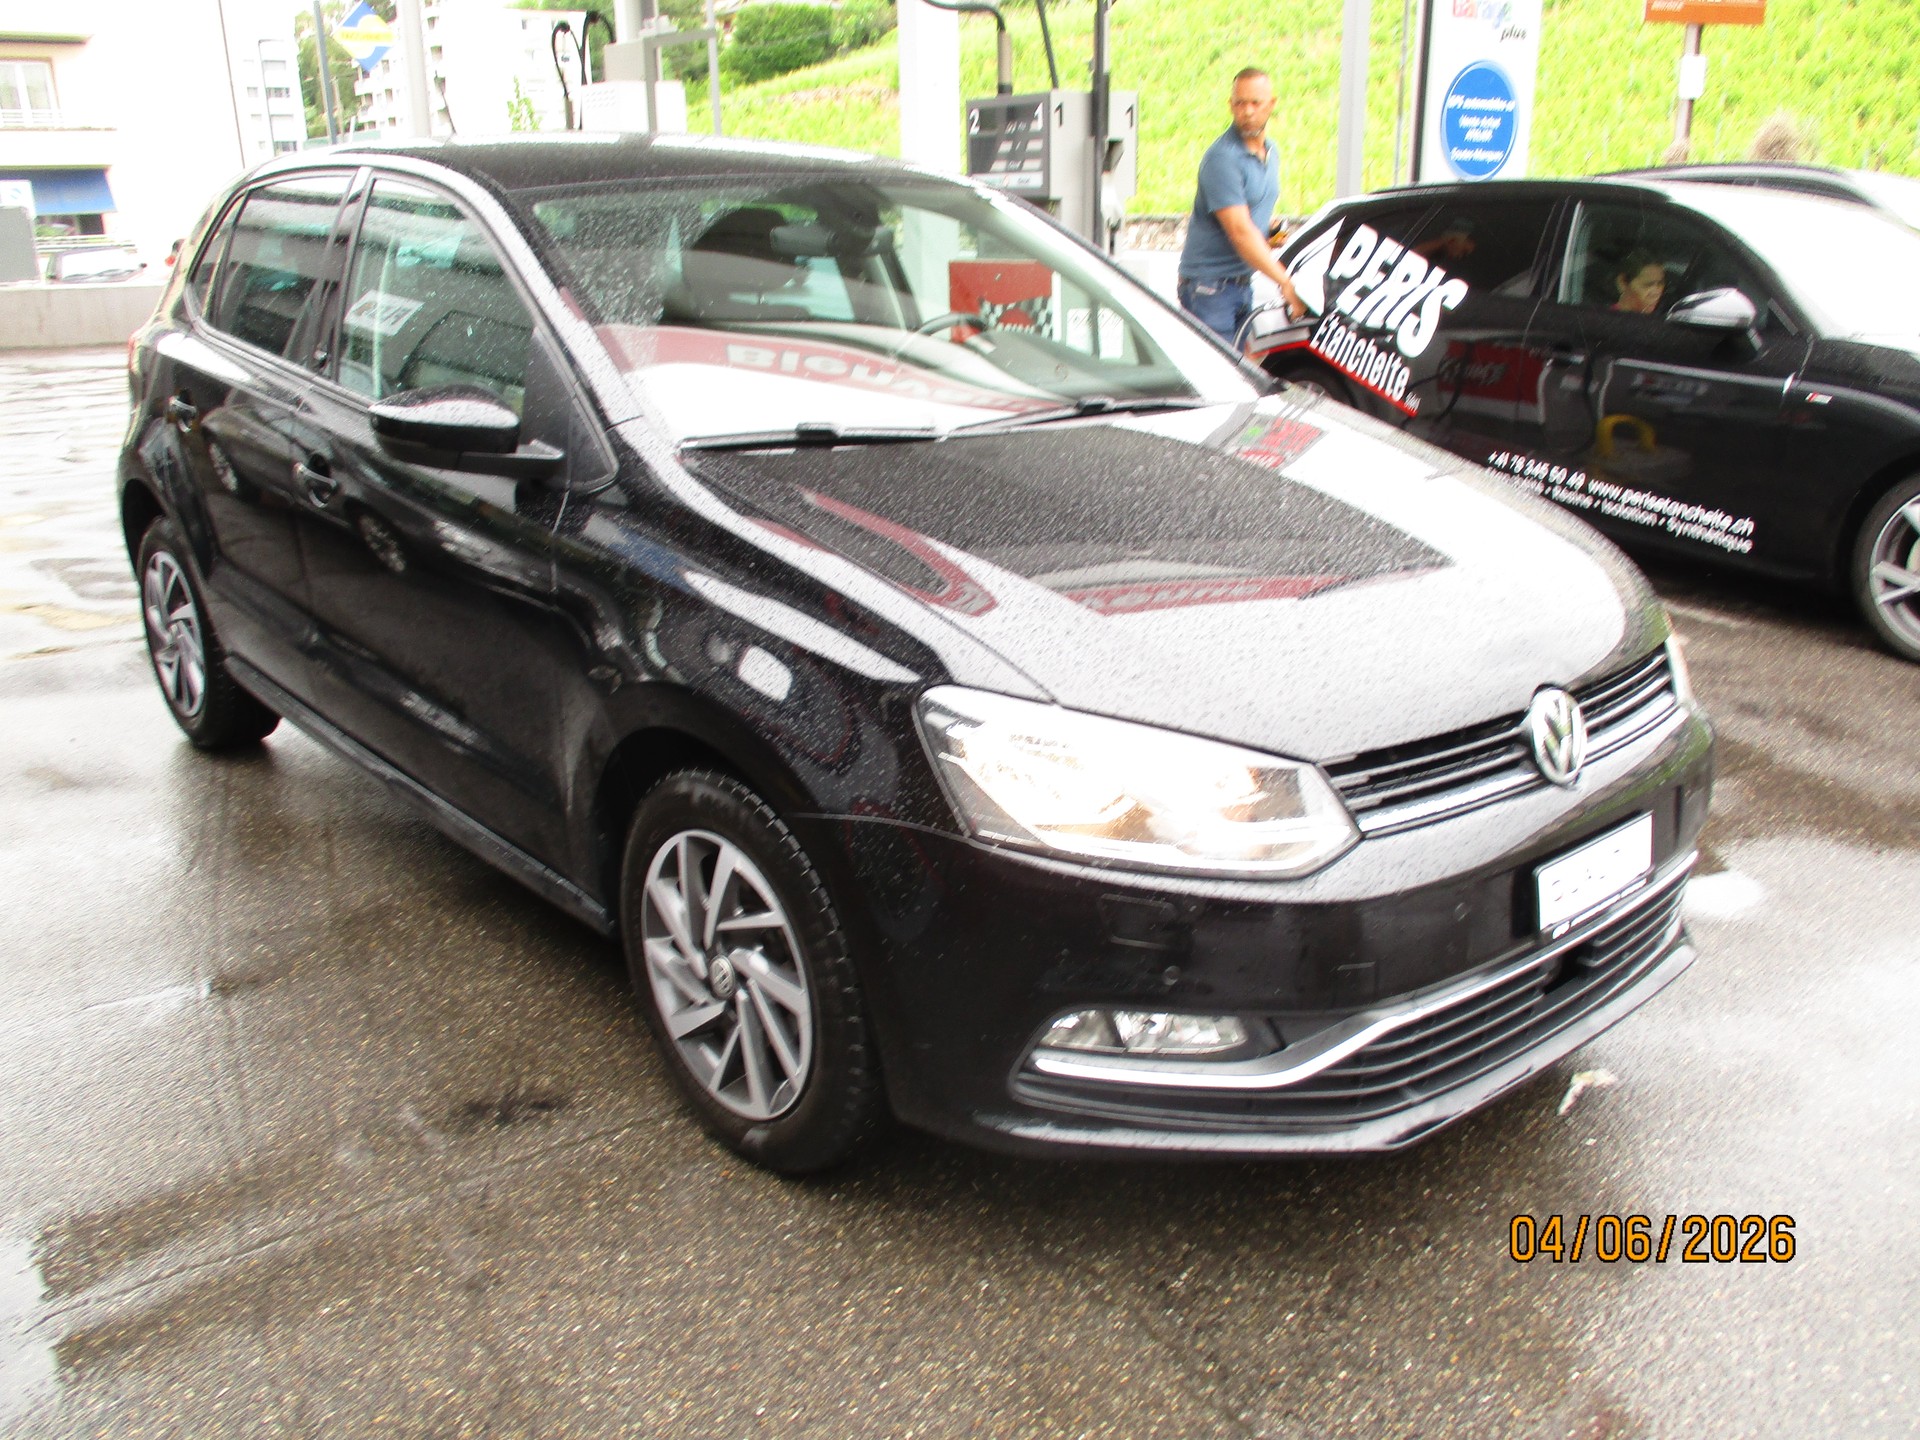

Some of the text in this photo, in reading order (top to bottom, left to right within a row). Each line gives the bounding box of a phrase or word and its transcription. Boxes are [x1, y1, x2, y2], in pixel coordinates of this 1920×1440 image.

[1499, 25, 1527, 42] plus
[969, 108, 980, 135] 2
[1034, 102, 1044, 132] 1
[1054, 102, 1063, 127] 1
[1125, 104, 1135, 128] 1
[1328, 223, 1469, 358] PERIS
